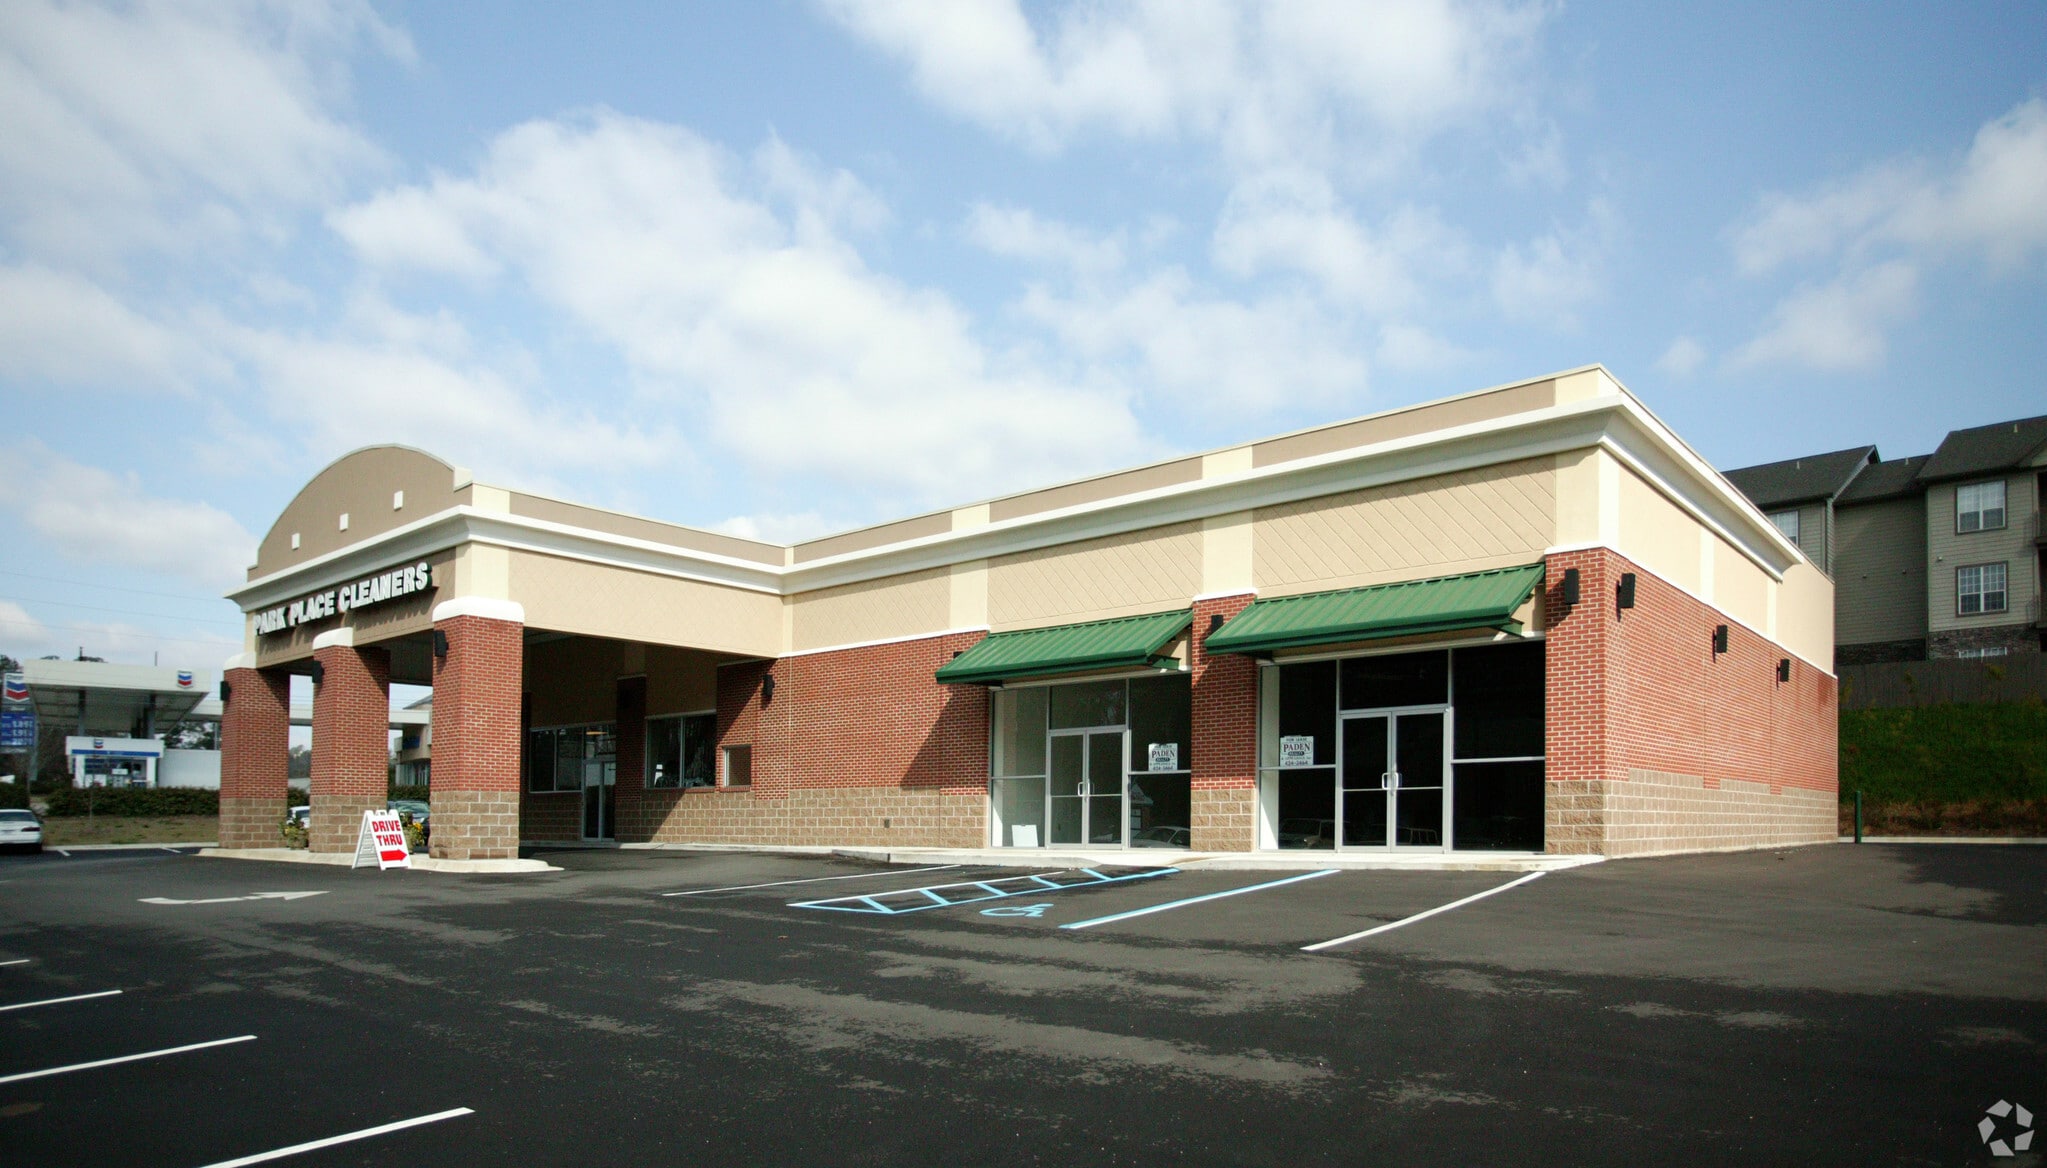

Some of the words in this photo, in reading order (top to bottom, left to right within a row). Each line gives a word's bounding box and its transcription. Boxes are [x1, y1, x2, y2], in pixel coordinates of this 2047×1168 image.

[253, 606, 287, 635] PARK
[289, 590, 336, 627] PLACE
[338, 562, 430, 613] CLEANERS
[1151, 749, 1175, 758] PADEN
[1283, 743, 1311, 752] PADEN
[371, 820, 401, 832] DRIVE
[376, 834, 403, 846] THRU
